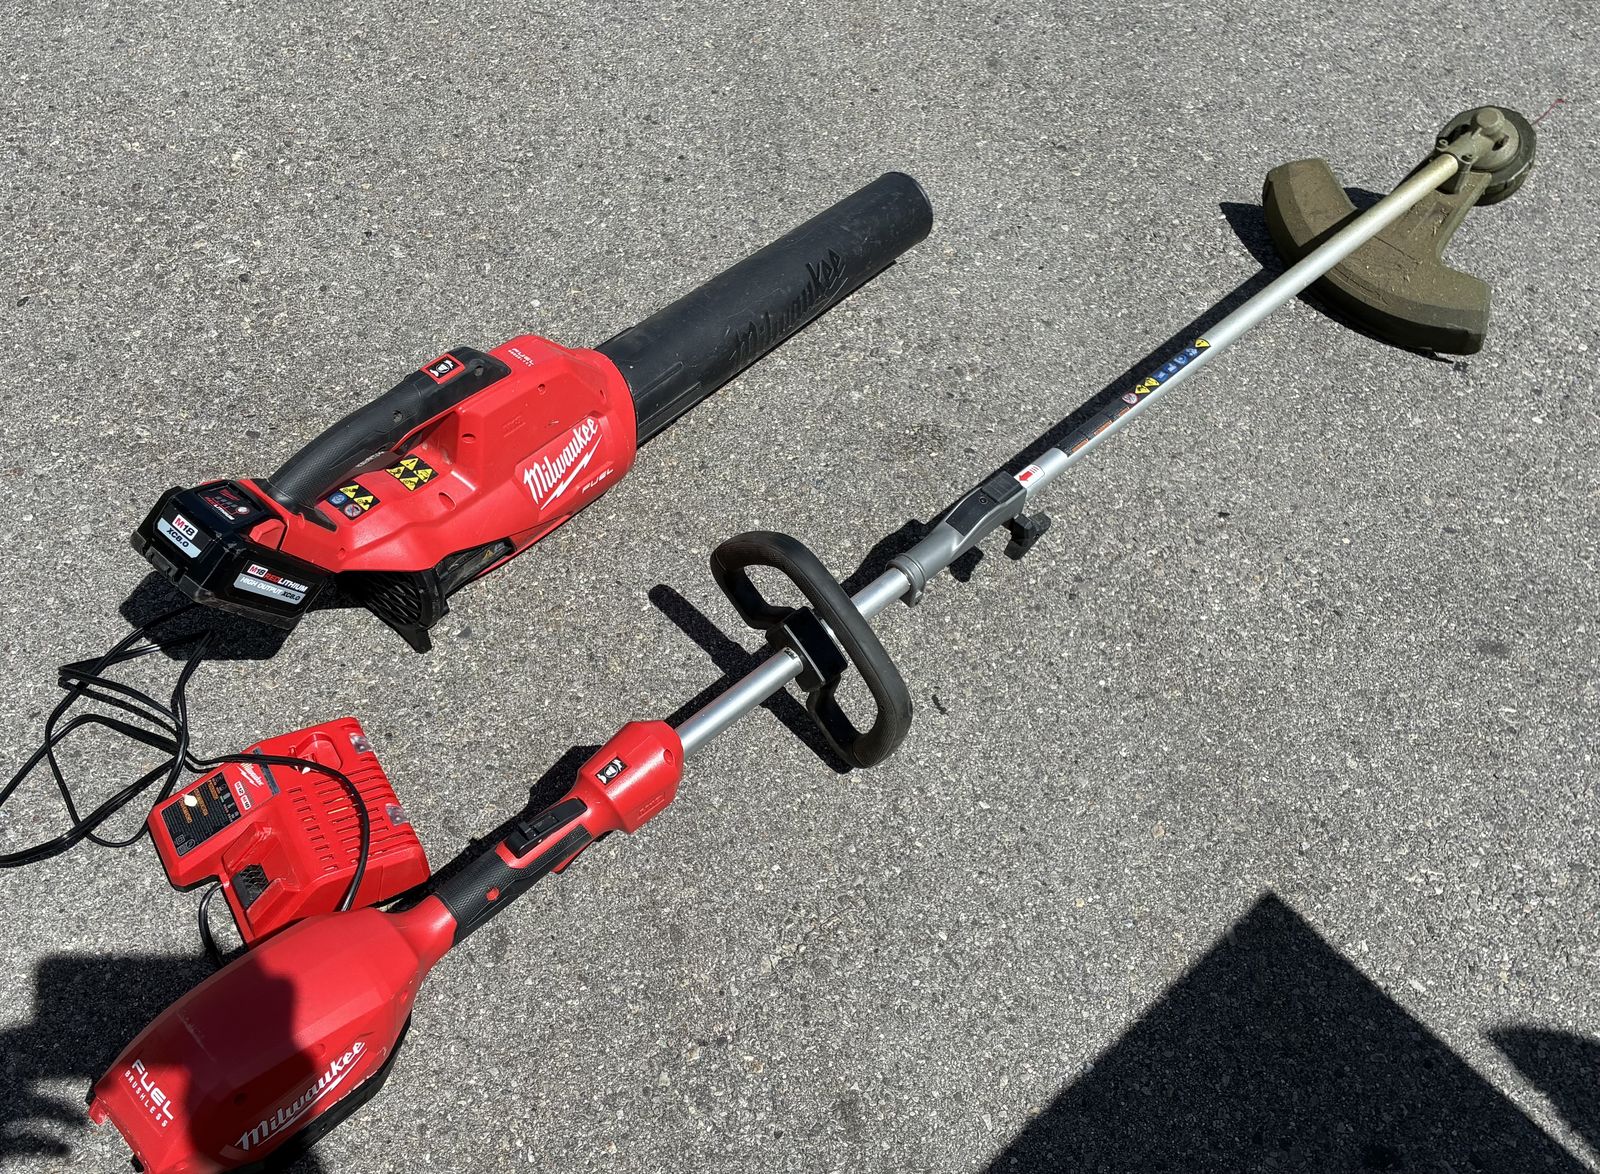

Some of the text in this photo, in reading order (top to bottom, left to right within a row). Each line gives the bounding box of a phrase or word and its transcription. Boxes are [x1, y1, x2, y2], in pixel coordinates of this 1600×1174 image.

[729, 247, 847, 368] Milwaukee
[523, 416, 599, 505] Milwaukee
[581, 467, 614, 494] FUEL
[166, 527, 190, 549] XC8.0
[174, 517, 196, 537] M18
[240, 576, 259, 589] HIGH
[257, 581, 283, 596] OUTPUT
[249, 564, 309, 593] M18 REDLITHIUM
[123, 1069, 168, 1129] BRUSHLESS
[131, 1058, 175, 1121] FUEL
[232, 1040, 366, 1152] Milwaukee
